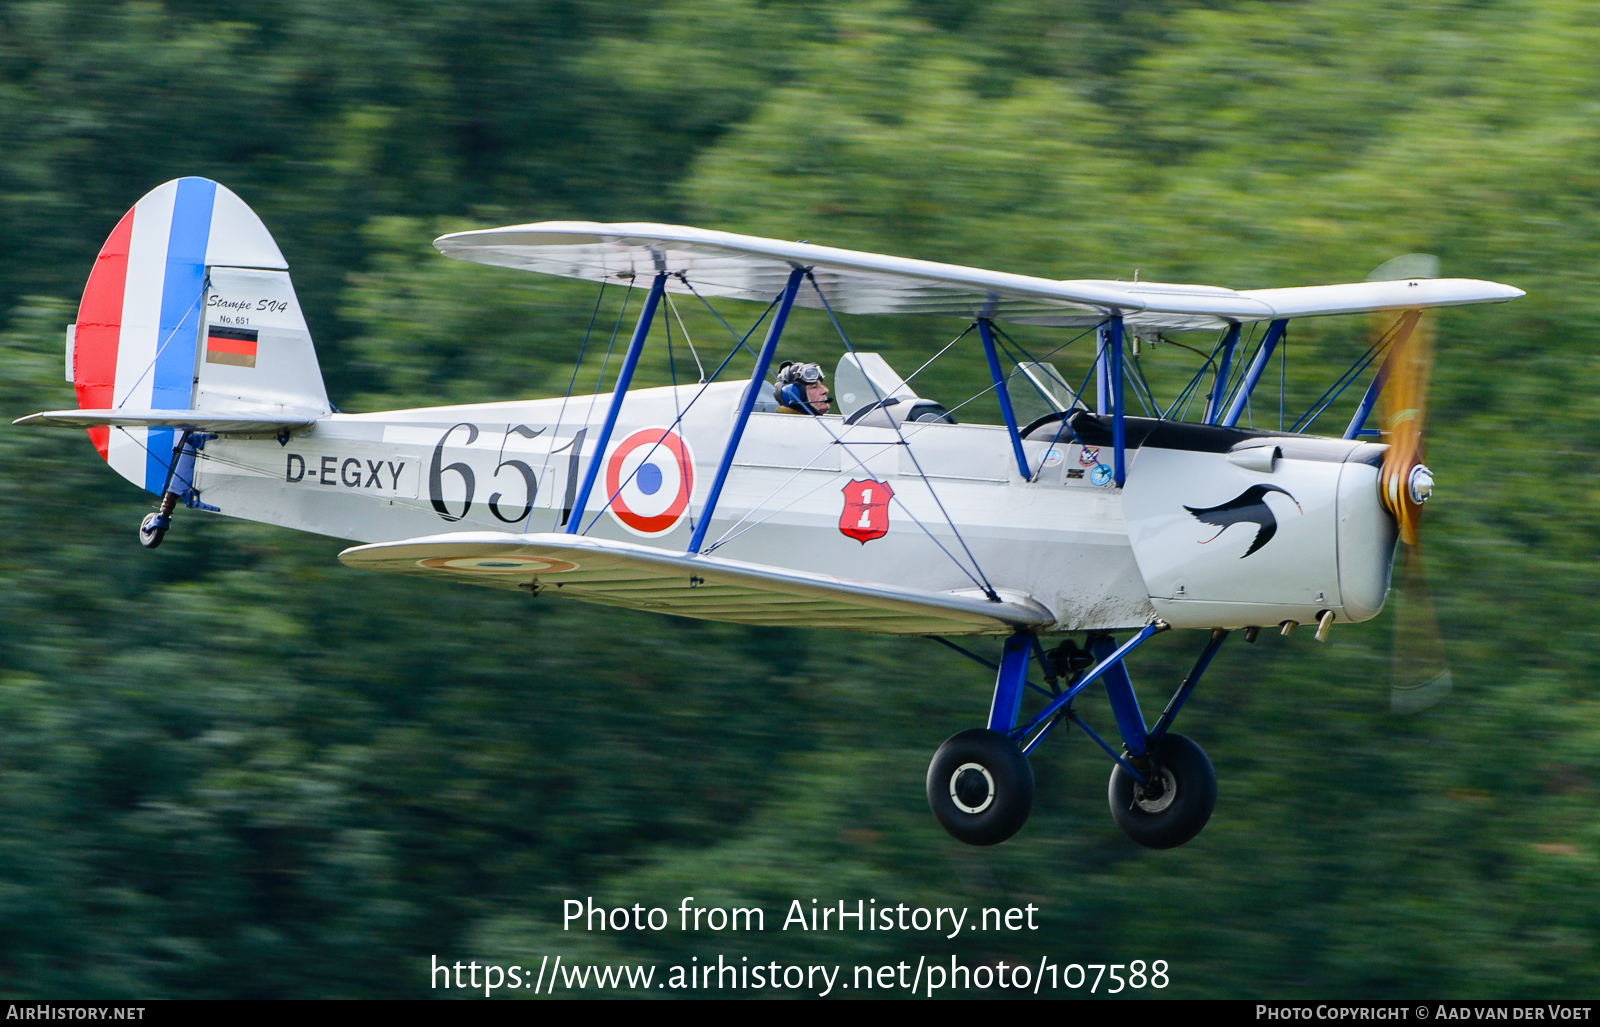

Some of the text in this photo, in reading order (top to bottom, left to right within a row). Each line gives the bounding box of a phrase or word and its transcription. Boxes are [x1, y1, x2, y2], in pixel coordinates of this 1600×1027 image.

[207, 294, 288, 313] Stampe SV4
[219, 315, 249, 325] No. 651
[286, 453, 405, 490] D-EGXY
[429, 422, 589, 527] 651
